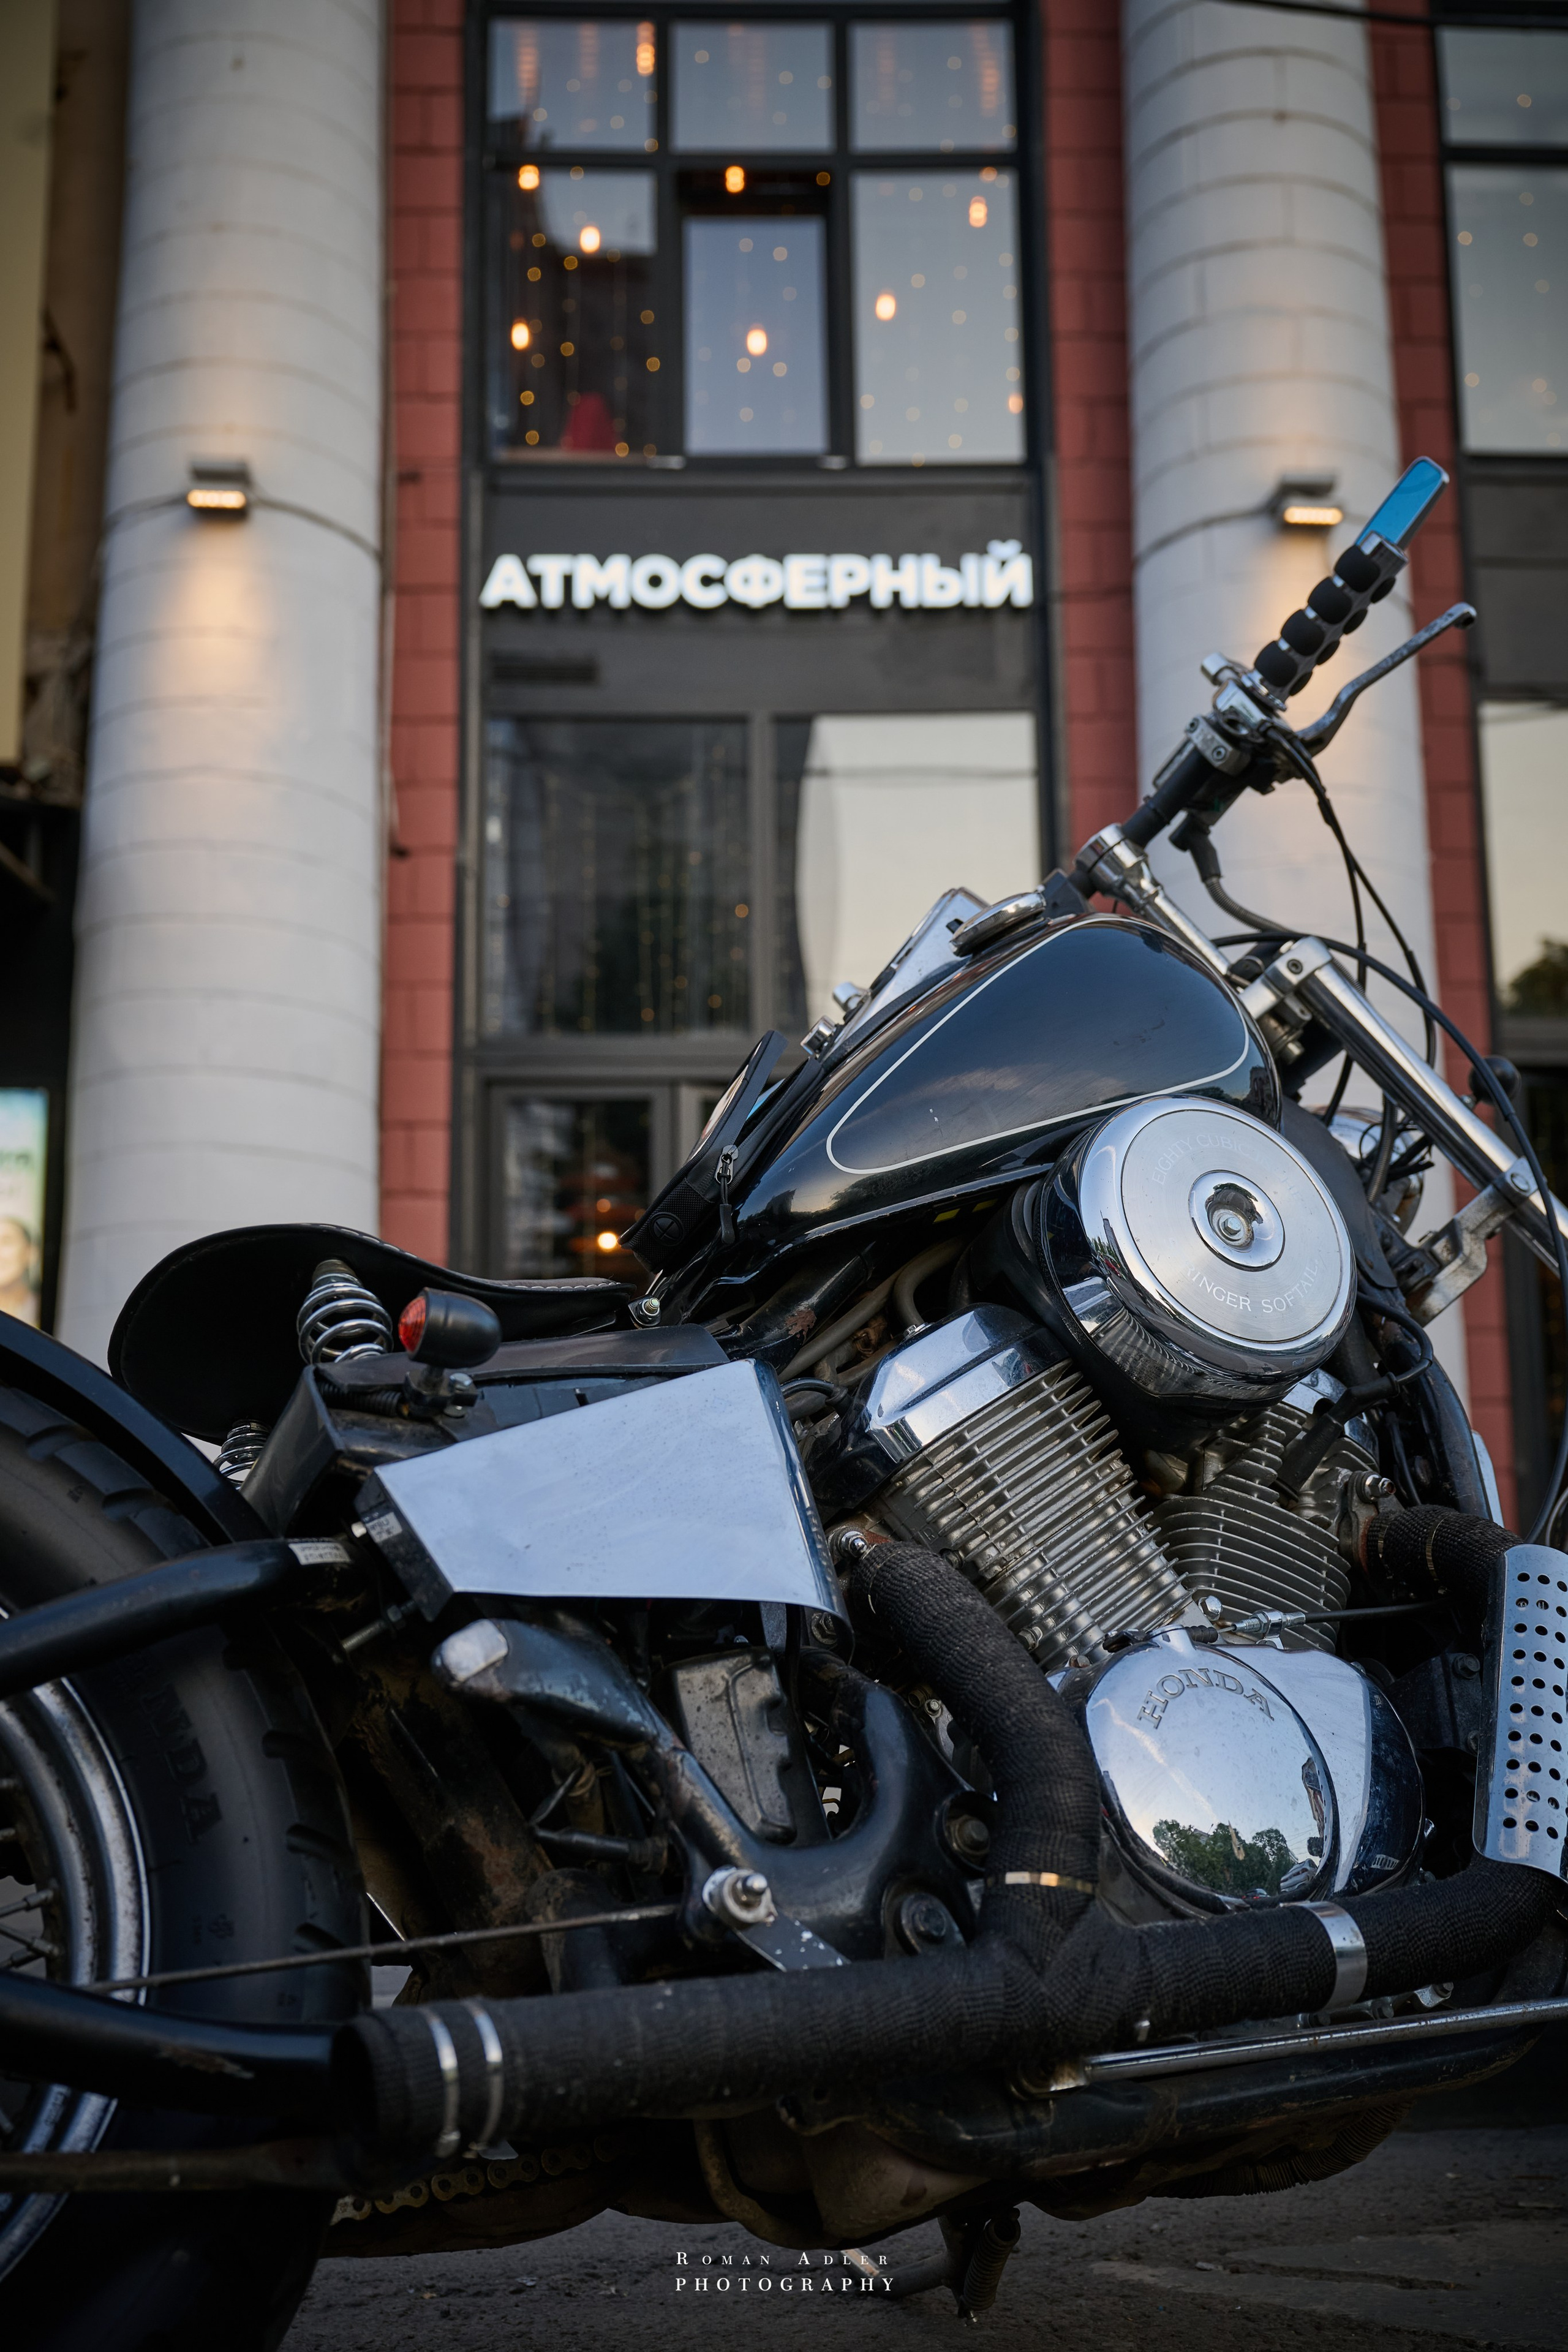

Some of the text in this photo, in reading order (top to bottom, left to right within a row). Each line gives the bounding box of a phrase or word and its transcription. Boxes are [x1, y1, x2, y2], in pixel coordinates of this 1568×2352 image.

[480, 539, 1034, 609] АТМОСФЕРНЫЙ
[1152, 1137, 1192, 1185] EIGHTY
[1196, 1134, 1250, 1156] CUBIC
[1137, 1667, 1275, 1730] HONDA
